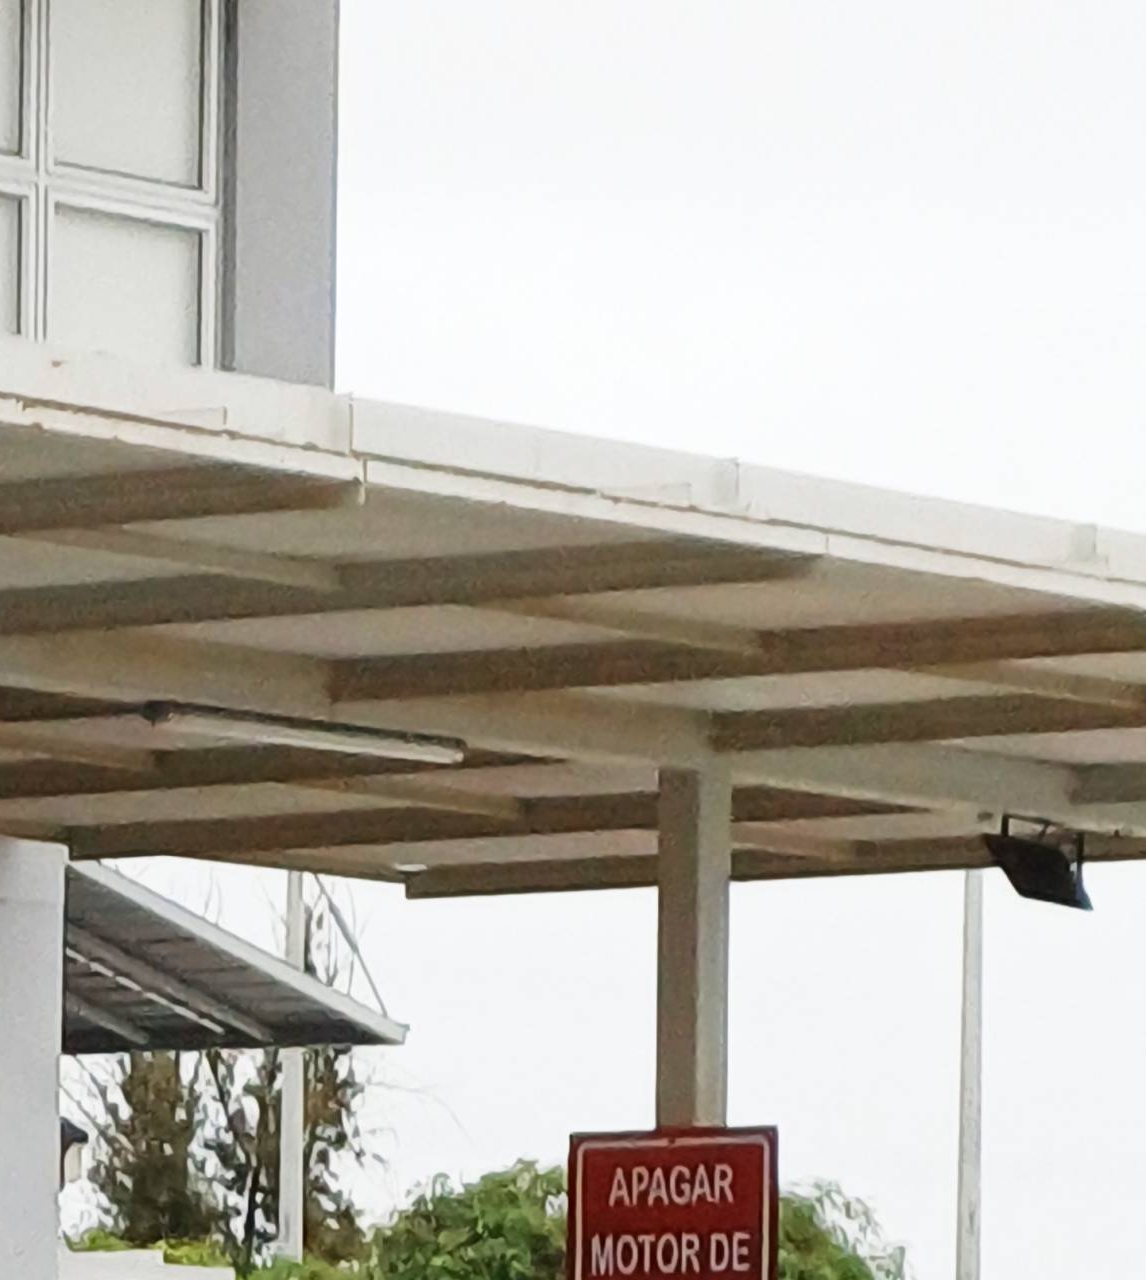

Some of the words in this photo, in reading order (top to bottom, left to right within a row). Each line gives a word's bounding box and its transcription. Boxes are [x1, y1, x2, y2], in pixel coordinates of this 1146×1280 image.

[608, 1163, 734, 1207] APAGAR
[591, 1232, 701, 1277] MOTOR
[710, 1232, 751, 1272] DE
